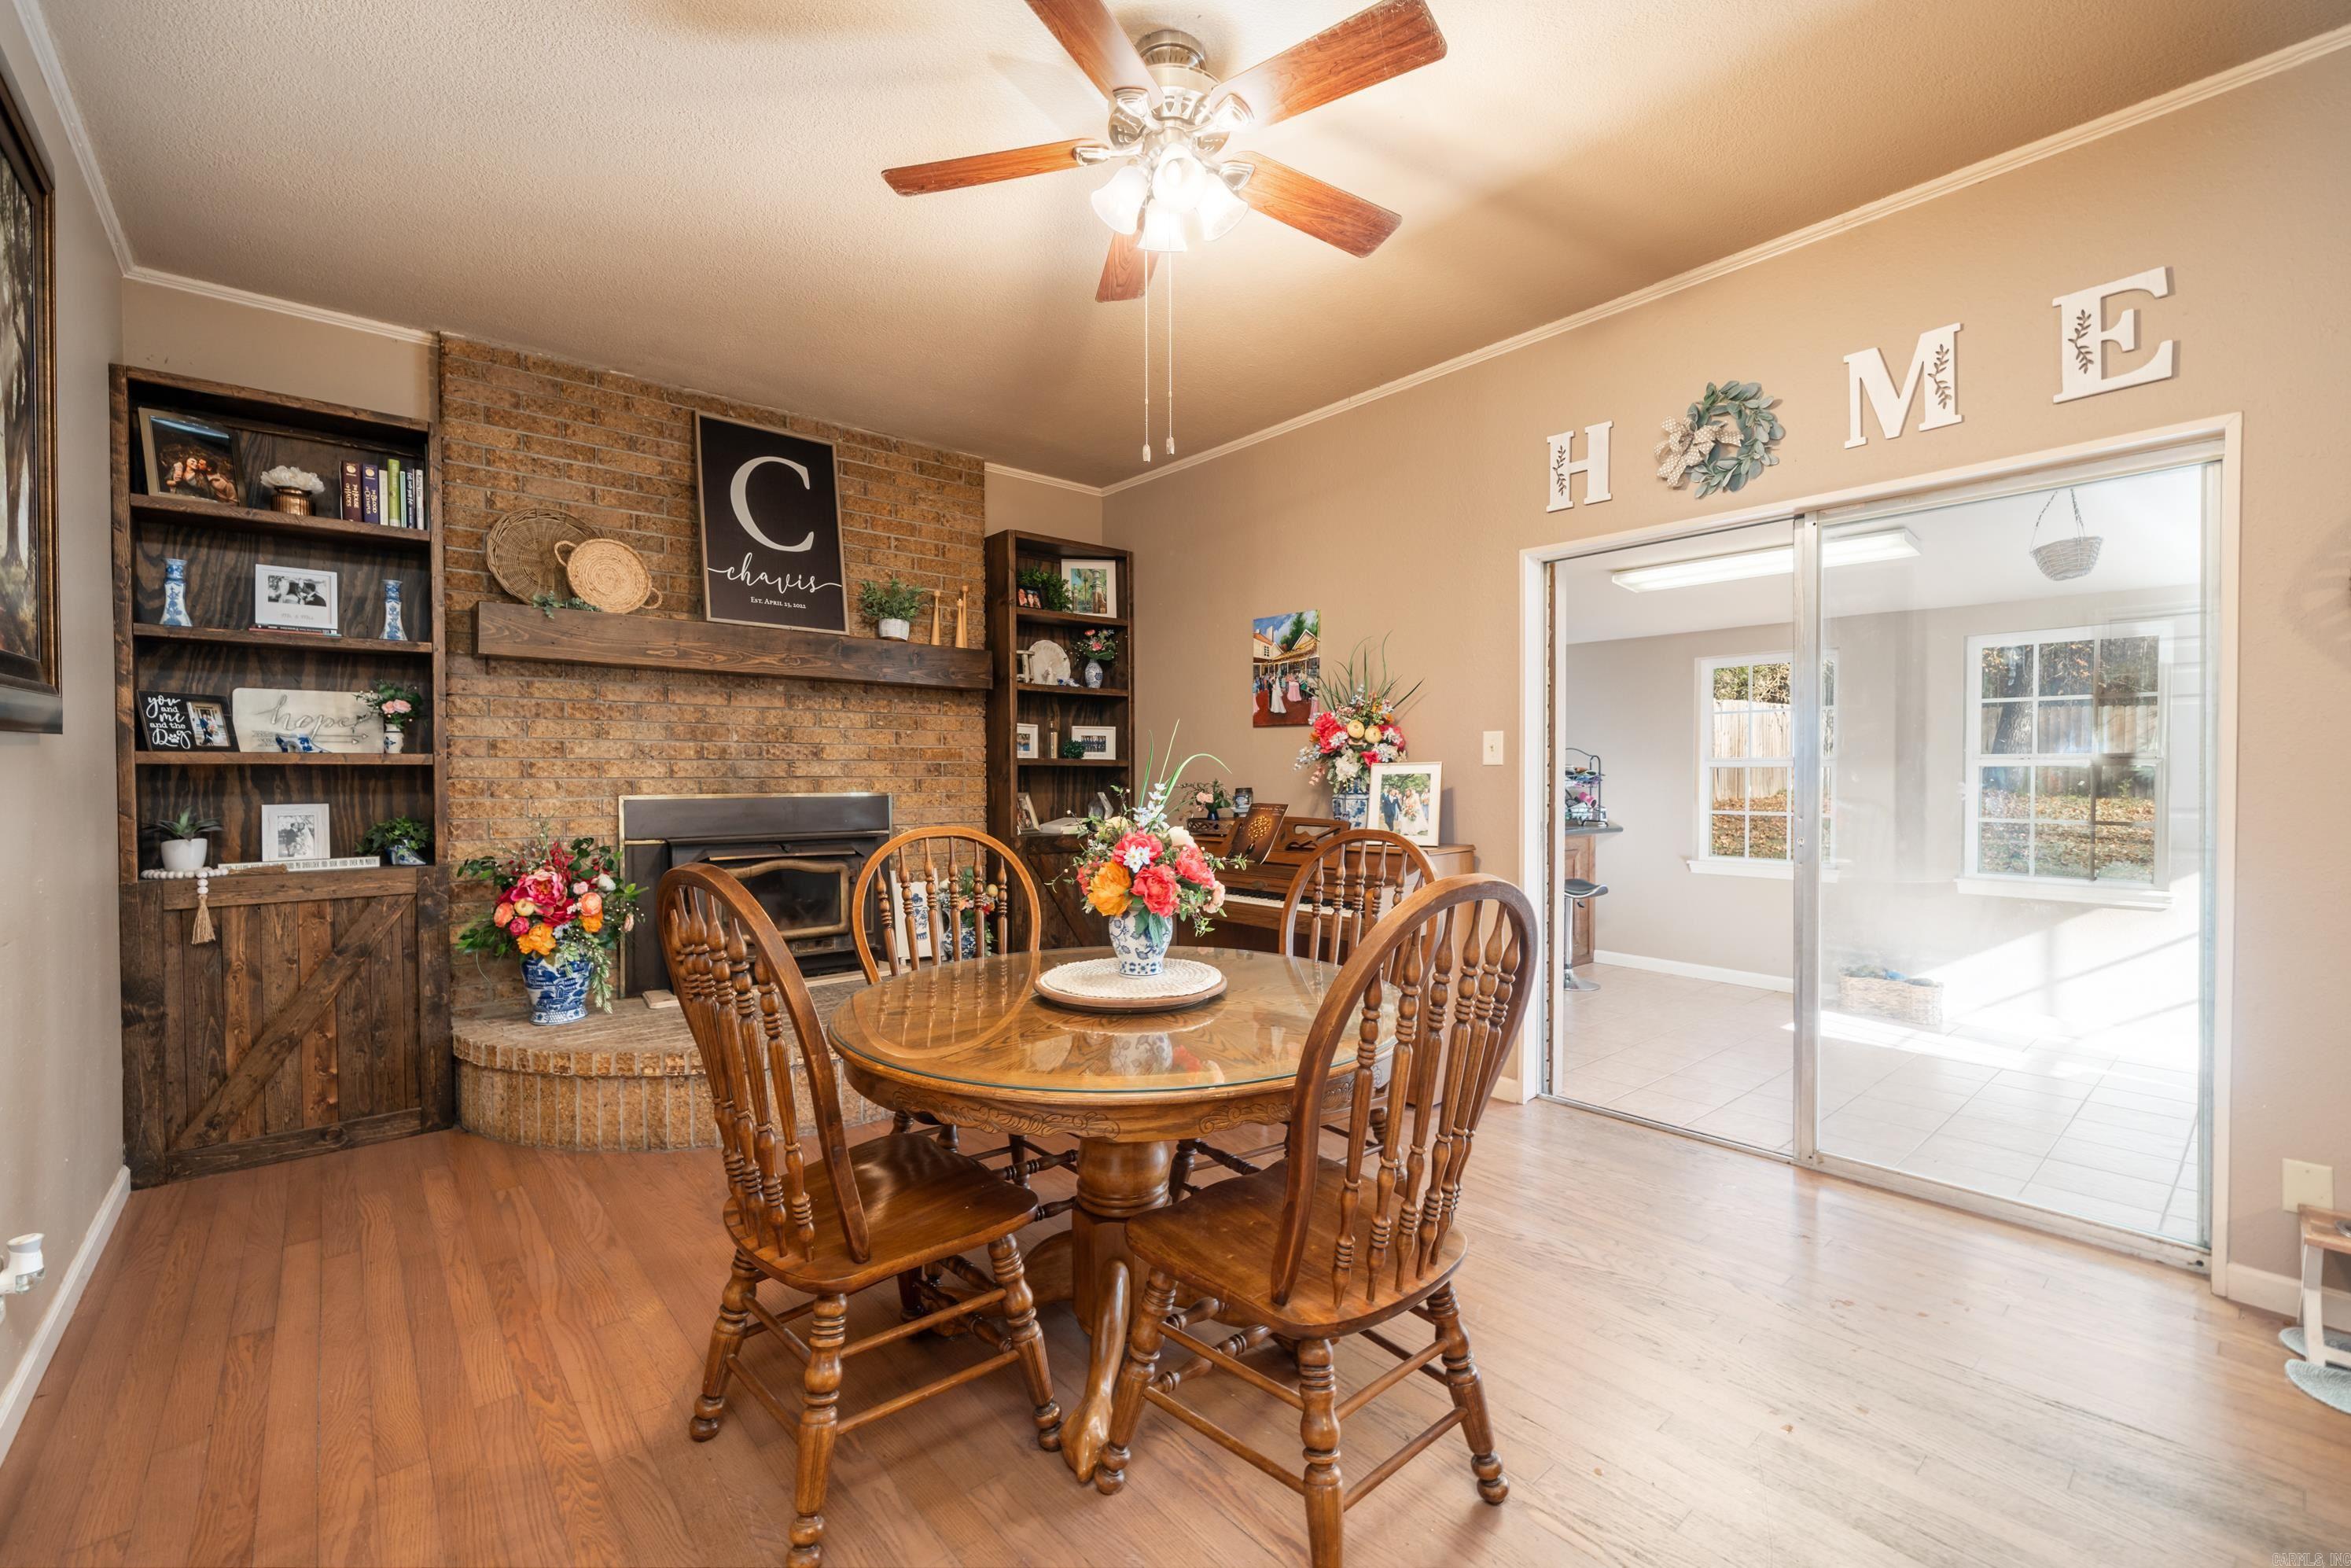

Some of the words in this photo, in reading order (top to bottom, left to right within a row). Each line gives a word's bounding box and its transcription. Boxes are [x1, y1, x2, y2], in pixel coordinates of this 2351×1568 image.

[730, 456, 814, 552] C
[707, 552, 842, 594] chavis
[145, 694, 181, 718] you
[159, 712, 185, 723] me
[255, 694, 360, 740] hope
[152, 728, 192, 749] Dg
